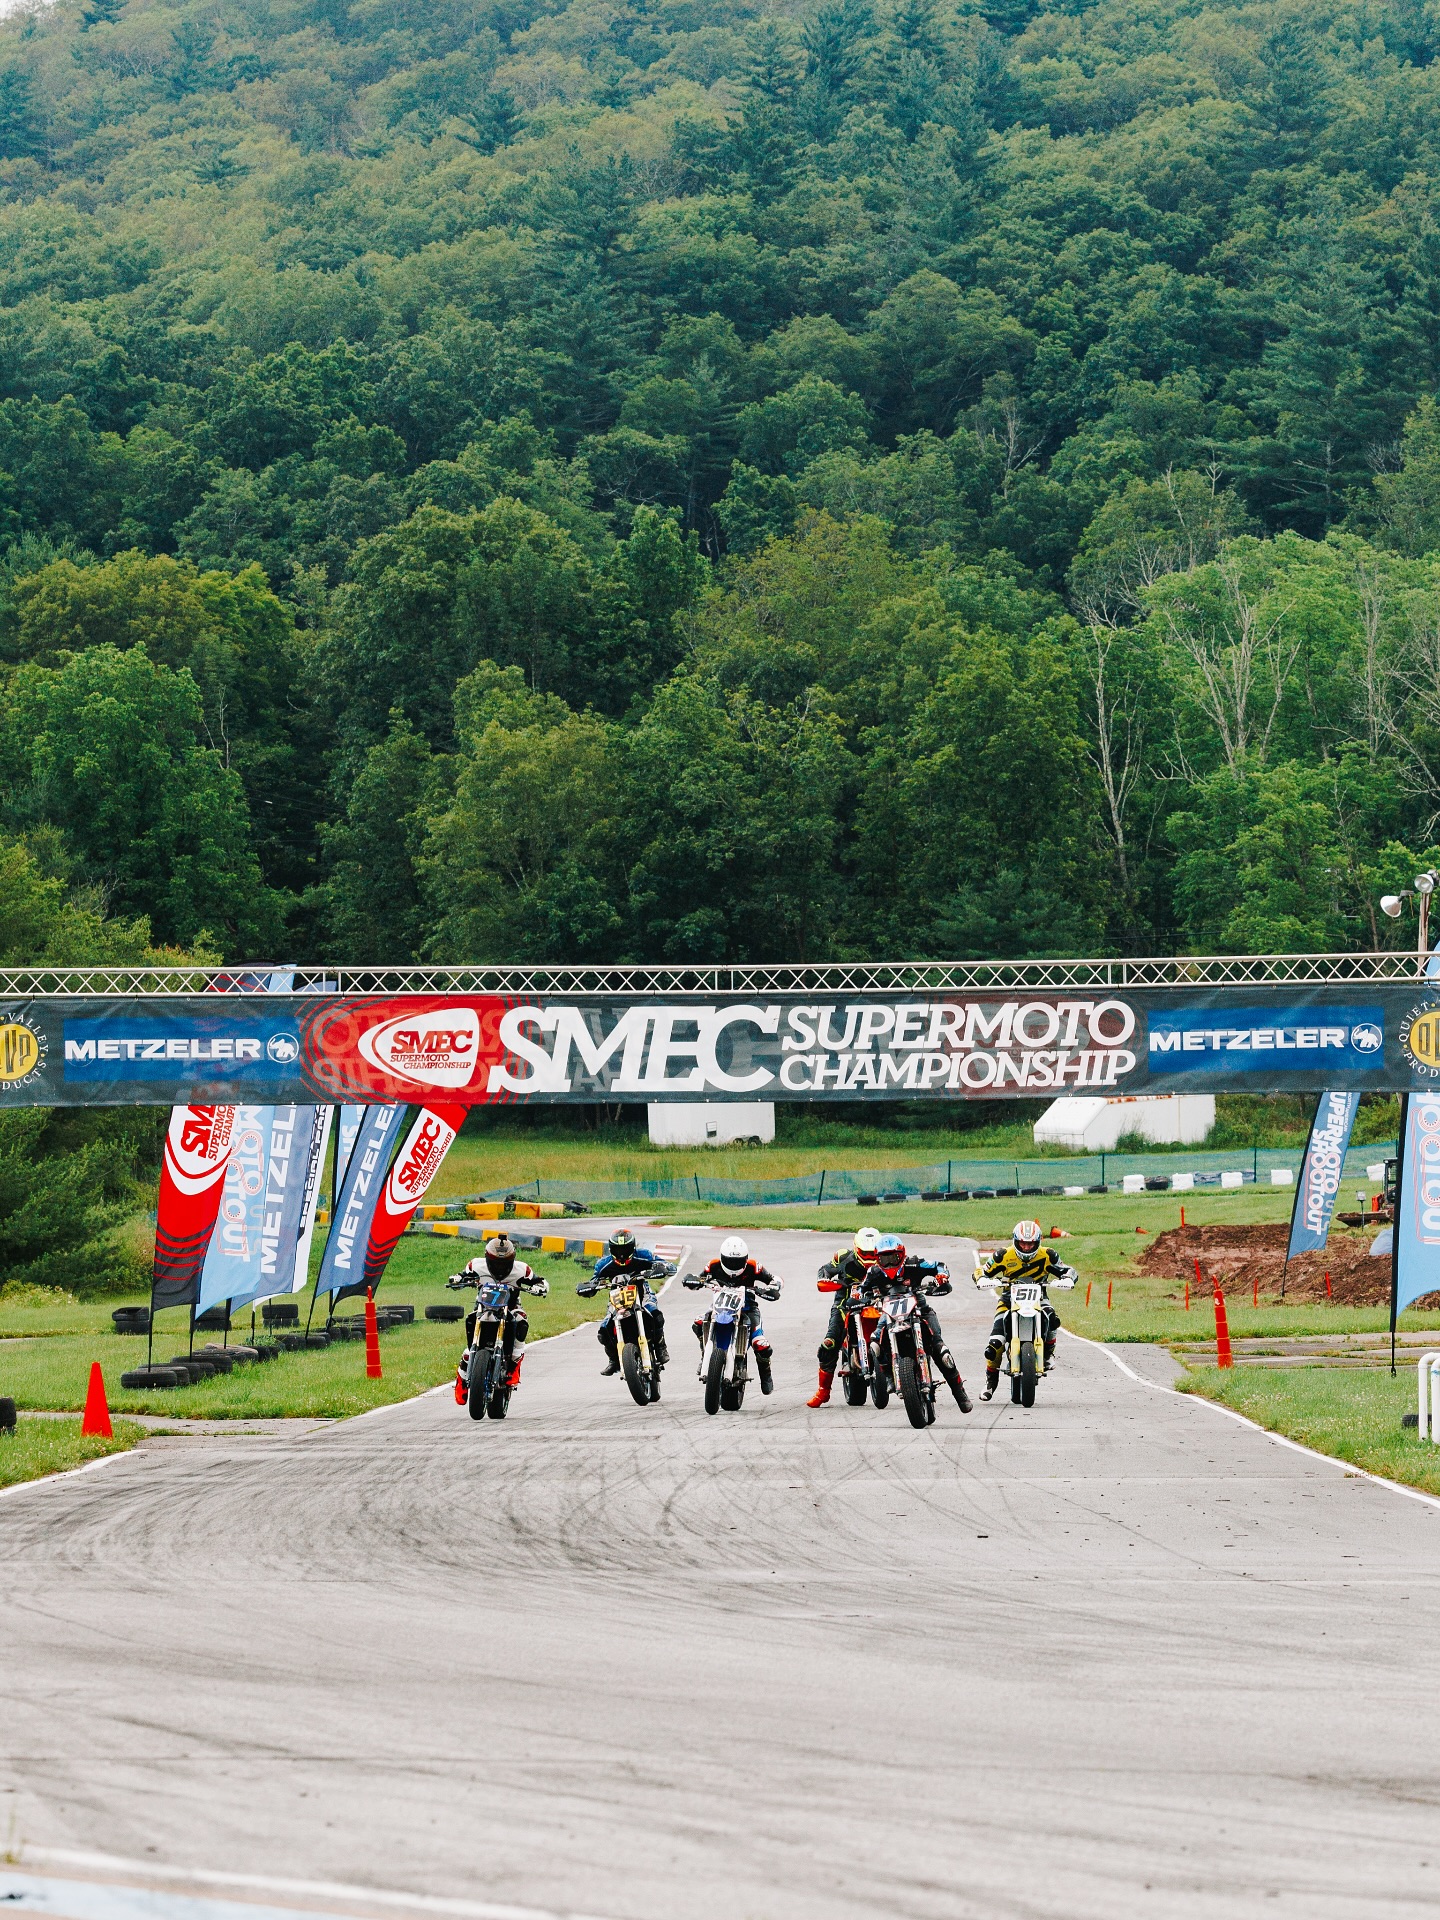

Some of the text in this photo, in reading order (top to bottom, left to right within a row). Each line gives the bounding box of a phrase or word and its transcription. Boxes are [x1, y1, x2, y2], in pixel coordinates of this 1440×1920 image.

[8, 1012, 49, 1053] VALLEY
[782, 1001, 1135, 1051] SUPERMOTO
[1398, 1001, 1430, 1043] QUIET
[65, 1038, 261, 1060] METZELER
[390, 1029, 473, 1054] SMEC
[486, 1004, 782, 1093] SMEC
[1149, 1028, 1345, 1052] METZELER
[390, 1053, 450, 1063] SUPERMOTO
[403, 1061, 472, 1070] CHAMPIONSHIP
[780, 1049, 1137, 1091] CHAMPIONSHIP
[398, 1117, 441, 1192] SMEC
[410, 1145, 440, 1196] SUPERMOTO
[422, 1131, 453, 1188] CHAMPIONSHIP
[1307, 1128, 1327, 1236] SHOOTOUT
[490, 1291, 500, 1305] 7
[715, 1292, 742, 1309] 410
[890, 1297, 908, 1316] 71
[1015, 1288, 1038, 1301] 511
